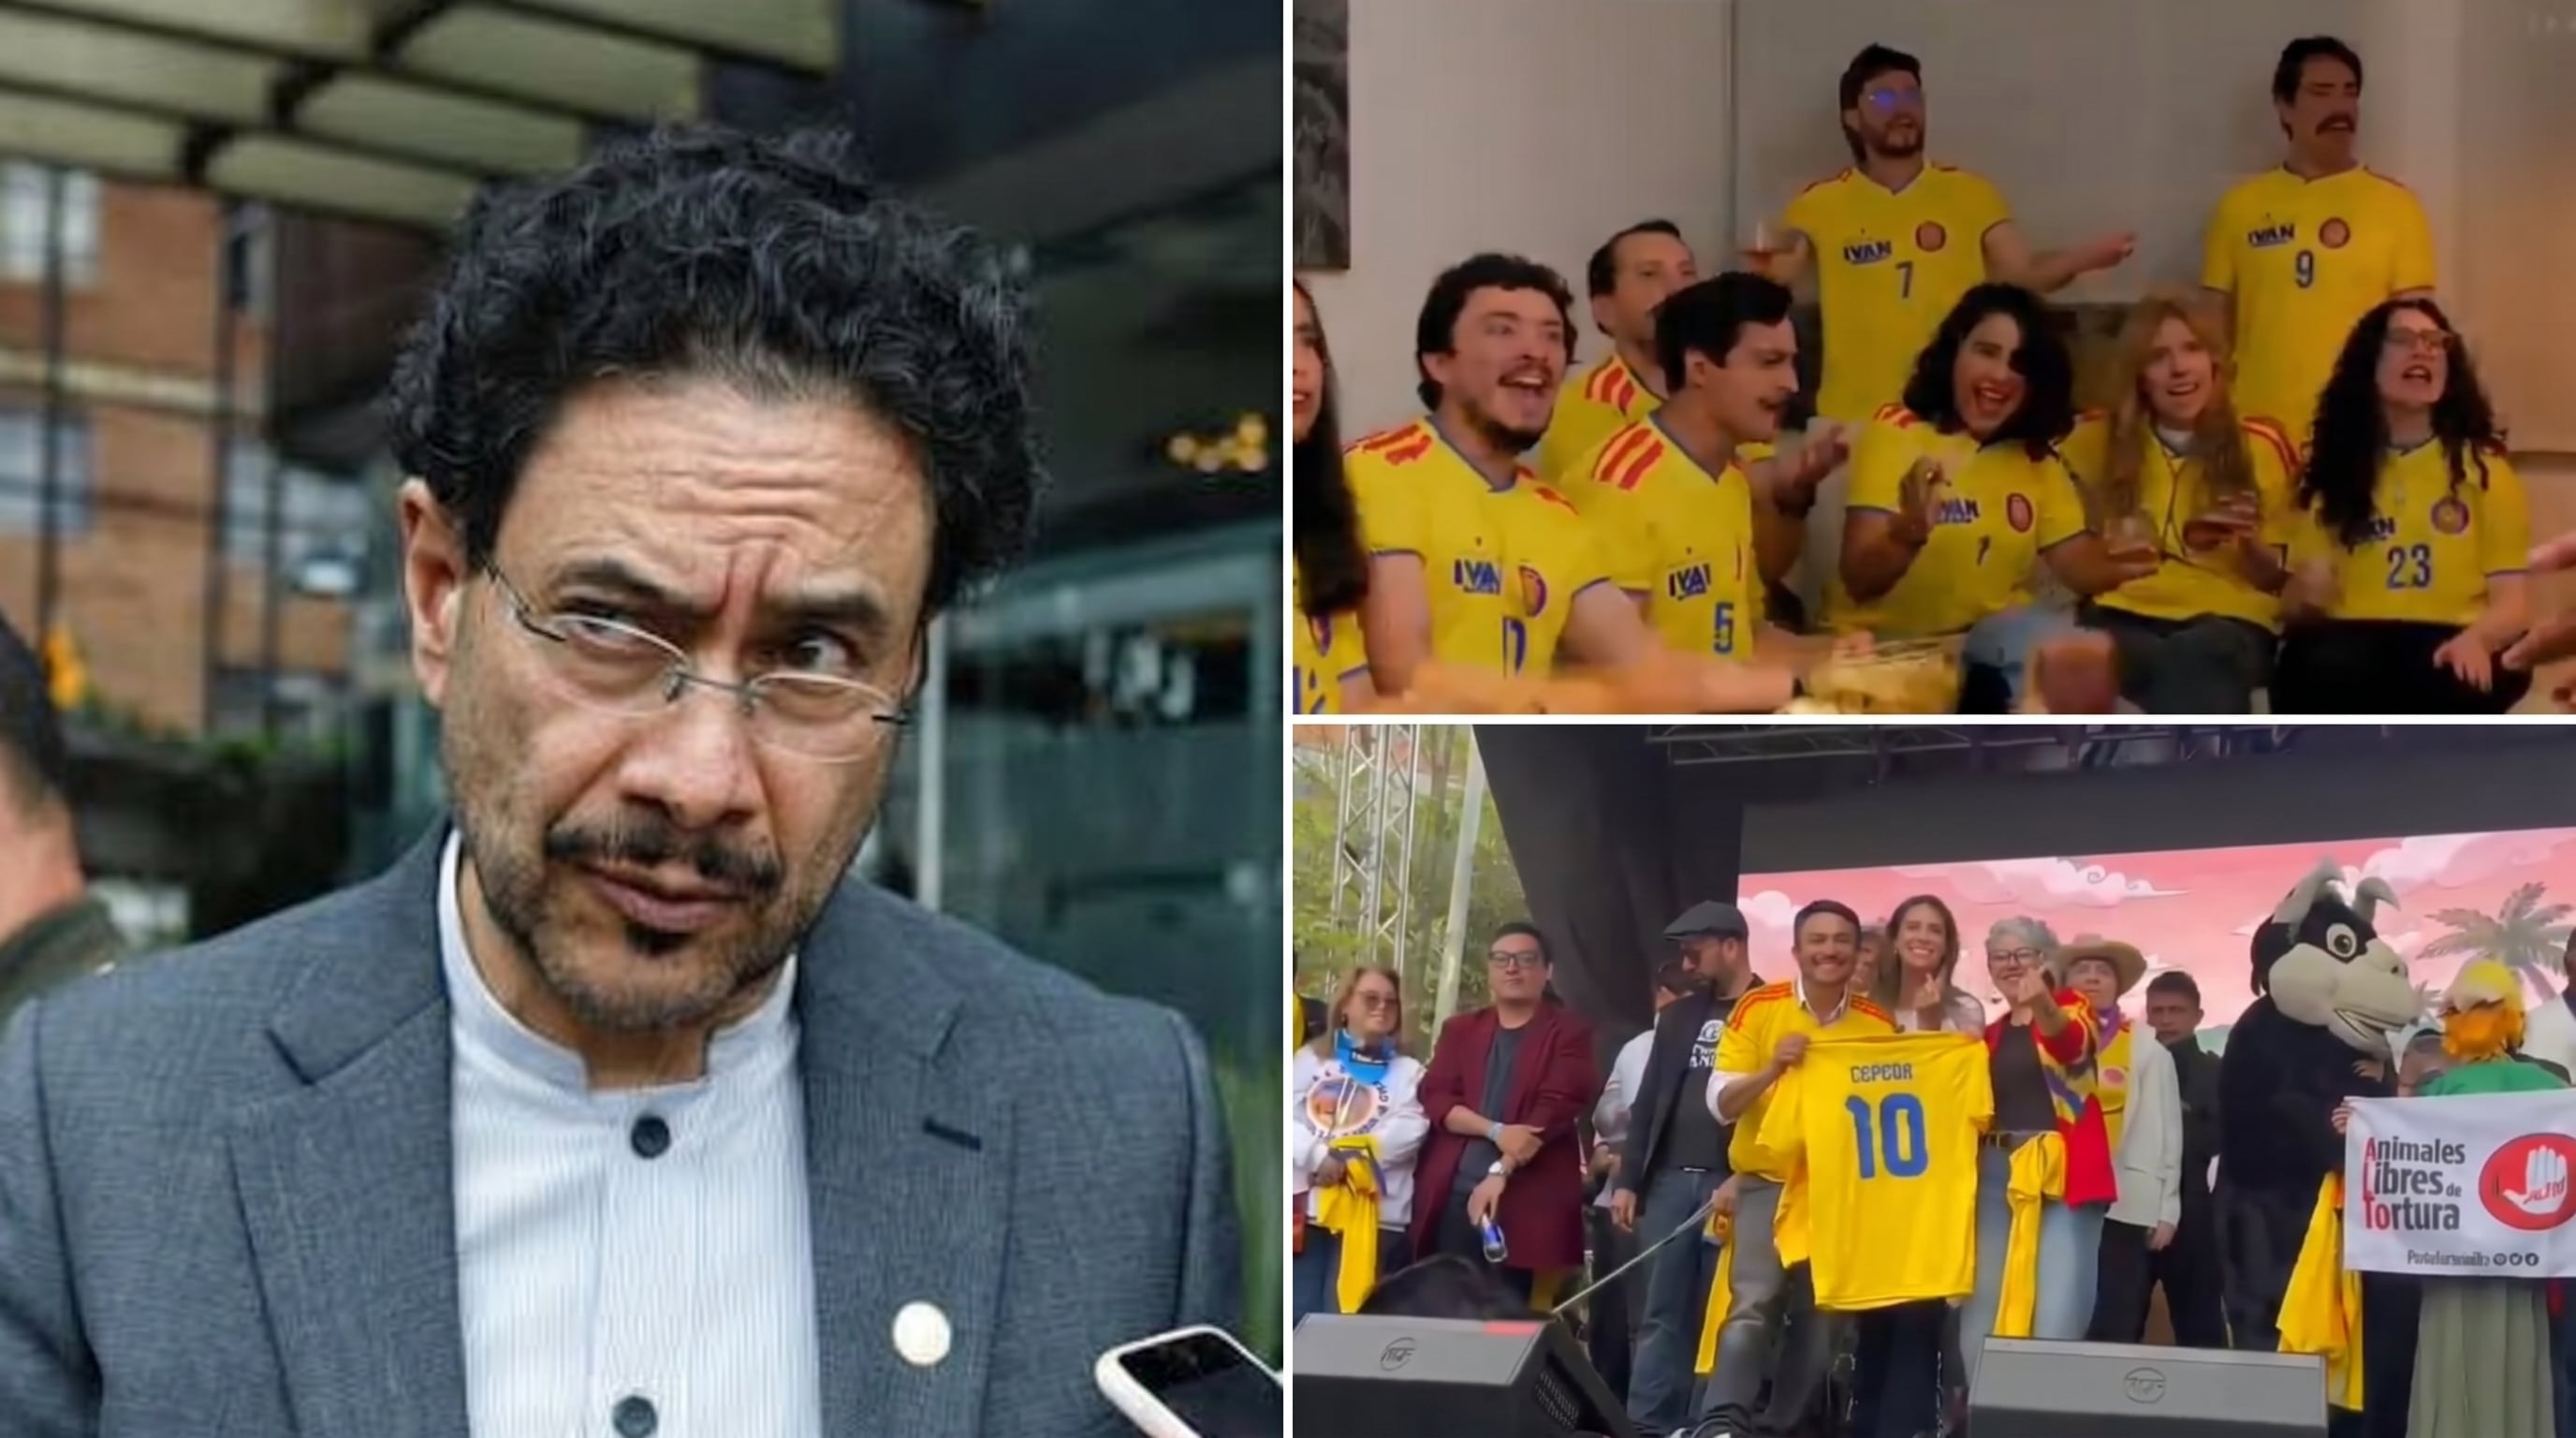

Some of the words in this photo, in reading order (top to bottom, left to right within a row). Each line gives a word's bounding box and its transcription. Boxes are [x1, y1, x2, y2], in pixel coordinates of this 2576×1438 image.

[2295, 249, 2314, 289] 9
[2387, 543, 2431, 589] 23
[1714, 602, 1734, 653] 5
[1845, 1092, 1929, 1180] 10
[2364, 1136, 2466, 1165] Animales
[2363, 1162, 2444, 1196] Libres
[2446, 1182, 2462, 1197] de
[2364, 1193, 2461, 1230] Tortura
